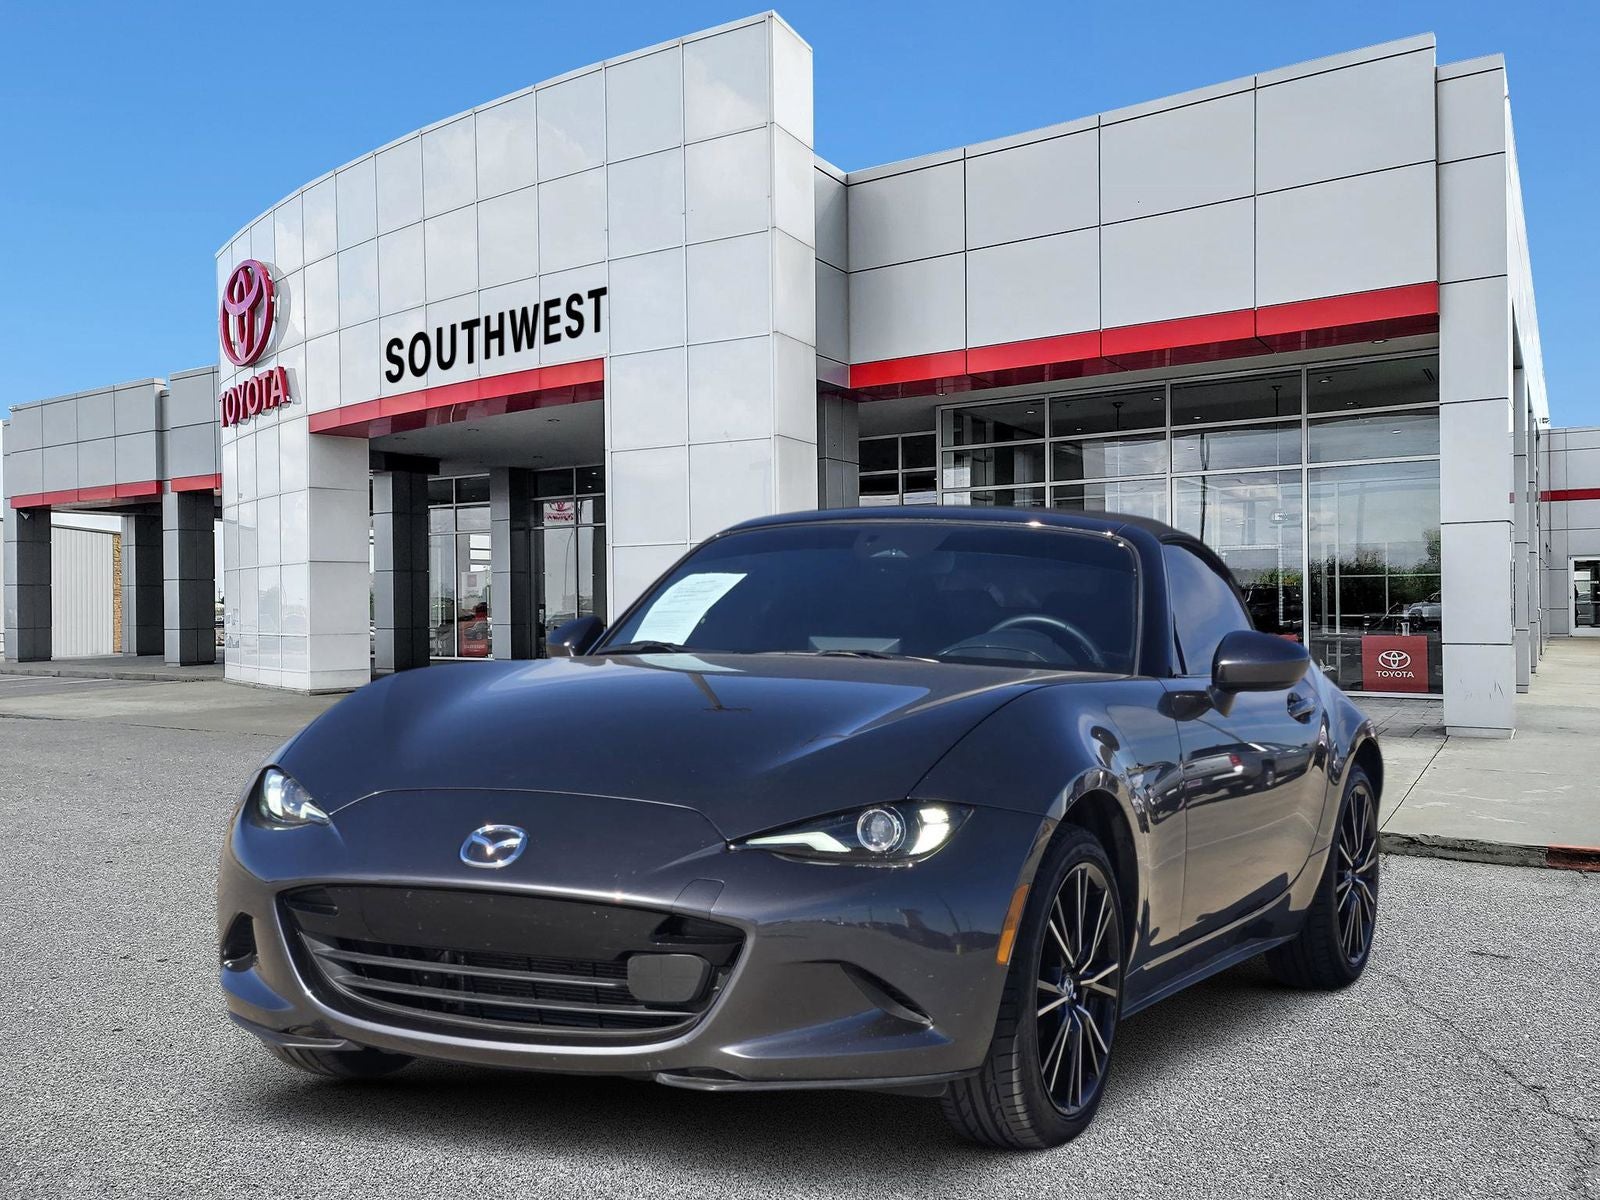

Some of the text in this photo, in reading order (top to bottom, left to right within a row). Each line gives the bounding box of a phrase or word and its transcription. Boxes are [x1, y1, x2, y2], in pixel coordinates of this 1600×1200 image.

[385, 286, 608, 384] SOUTHWEST
[218, 366, 290, 428] TOYOTA
[1375, 670, 1415, 678] TOYOTA
